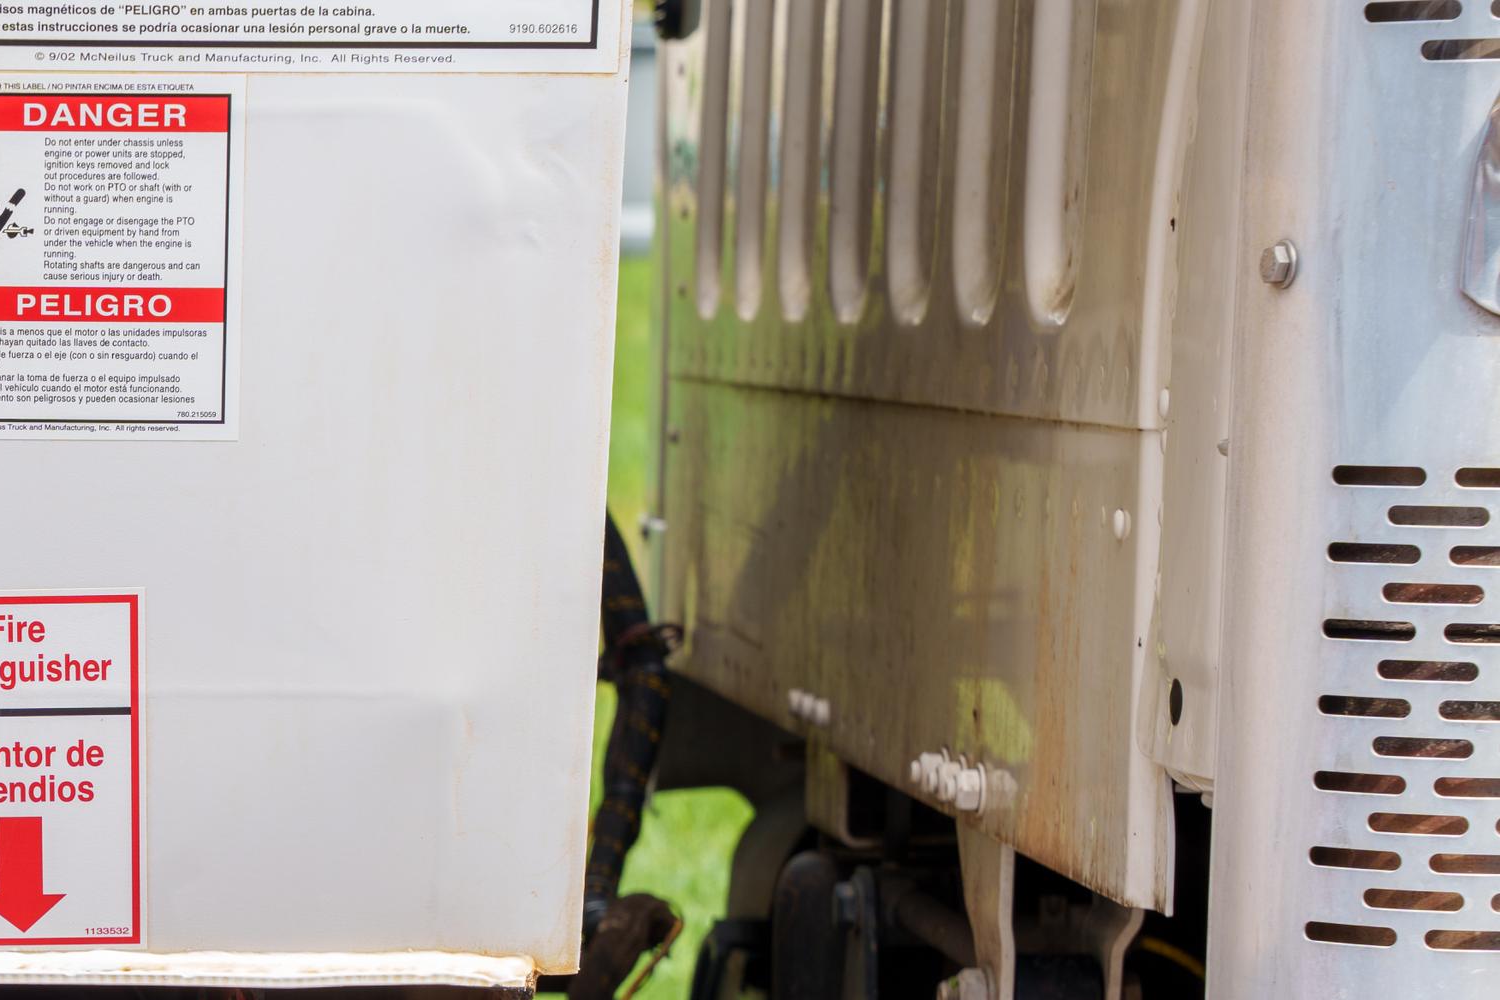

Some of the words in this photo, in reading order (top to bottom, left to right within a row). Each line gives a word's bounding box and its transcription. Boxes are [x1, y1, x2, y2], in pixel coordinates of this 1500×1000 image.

[27, 3, 97, 17] magnéticos
[100, 4, 115, 15] de
[189, 7, 205, 15] en
[208, 4, 248, 16] ambas
[251, 5, 297, 18] puertas
[300, 5, 315, 16] de
[318, 5, 329, 16] la
[332, 5, 375, 16] cabina.
[1, 20, 34, 31] estas
[37, 20, 118, 32] instrucciones
[122, 23, 136, 32] se
[180, 21, 240, 33] ocasionar
[243, 24, 265, 33] una
[268, 22, 305, 33] lesión
[308, 22, 360, 36] personal
[363, 25, 397, 36] grave
[400, 25, 408, 34] o
[411, 23, 422, 34] la
[425, 23, 470, 34] muerte.
[509, 23, 578, 34] 9190.602616
[48, 51, 76, 61] 9/02
[79, 52, 136, 61] McNeilus
[140, 52, 174, 62] Truck
[178, 52, 201, 62] and
[205, 52, 295, 64] Manufacturing,
[300, 53, 321, 62] Inc.
[330, 53, 346, 63] All
[351, 53, 390, 65] Rights
[394, 53, 455, 63] Reserved.
[3, 82, 21, 90] THIS
[22, 82, 46, 90] LABEL
[51, 82, 64, 90] NO
[64, 82, 92, 90] PINTAR
[93, 82, 124, 91] ENCIMA
[124, 83, 135, 91] DE
[136, 83, 156, 91] ESTA
[157, 83, 194, 91] ETIQUETA
[23, 102, 187, 127] DANGER
[44, 137, 57, 147] Do
[58, 137, 72, 147] not
[73, 137, 95, 147] enter
[97, 138, 122, 147] under
[122, 138, 155, 148] chassis
[156, 138, 184, 148] unless
[44, 148, 72, 160] engine
[84, 151, 111, 161] power
[112, 149, 133, 159] units
[134, 151, 148, 159] are
[149, 149, 186, 161] stopped,
[44, 160, 74, 172] ignition
[76, 160, 95, 172] keys
[97, 160, 133, 170] removed
[134, 160, 151, 170] and
[152, 161, 170, 170] lock
[43, 171, 58, 180] out
[59, 171, 106, 183] procedures
[107, 173, 122, 181] are
[123, 171, 160, 181] followed.
[44, 182, 56, 192] Do
[58, 182, 71, 192] not
[73, 182, 93, 192] work
[94, 184, 106, 192] on
[107, 182, 127, 192] PTO
[139, 183, 160, 192] shaft
[161, 183, 182, 195] (with
[183, 185, 192, 193] or
[43, 193, 74, 203] without
[82, 194, 110, 205] guard)
[112, 194, 134, 203] when
[136, 194, 164, 206] engine
[166, 194, 173, 204] is
[43, 204, 77, 216] running.
[43, 216, 56, 225] Do
[57, 216, 71, 225] not
[72, 218, 104, 228] engage
[105, 218, 114, 226] or
[116, 216, 159, 228] disengage
[160, 216, 174, 226] the
[176, 217, 195, 226] PTO
[54, 227, 80, 237] driven
[81, 227, 125, 239] equipment
[126, 227, 137, 239] by
[138, 228, 160, 237] hand
[161, 228, 180, 237] from
[43, 238, 67, 248] under
[69, 238, 83, 248] the
[84, 238, 114, 248] vehicle
[115, 238, 138, 248] when
[139, 239, 153, 248] the
[154, 239, 183, 251] engine
[184, 239, 192, 248] is
[43, 249, 76, 261] running.
[43, 260, 78, 272] Rotating
[79, 260, 105, 270] shafts
[122, 261, 166, 273] dangerous
[167, 261, 184, 271] and
[185, 263, 201, 271] can
[42, 273, 68, 281] cause
[69, 271, 100, 281] serious
[101, 272, 125, 283] injury
[137, 272, 163, 282] death.
[16, 293, 173, 317] PELIGRO
[9, 328, 15, 336] a
[46, 329, 63, 338] que
[64, 327, 72, 336] el
[74, 327, 99, 336] motor
[107, 327, 121, 336] las
[122, 327, 161, 336] unidades
[162, 327, 207, 339] impulsoras
[66, 738, 105, 768] de
[85, 927, 130, 935] 1133532
